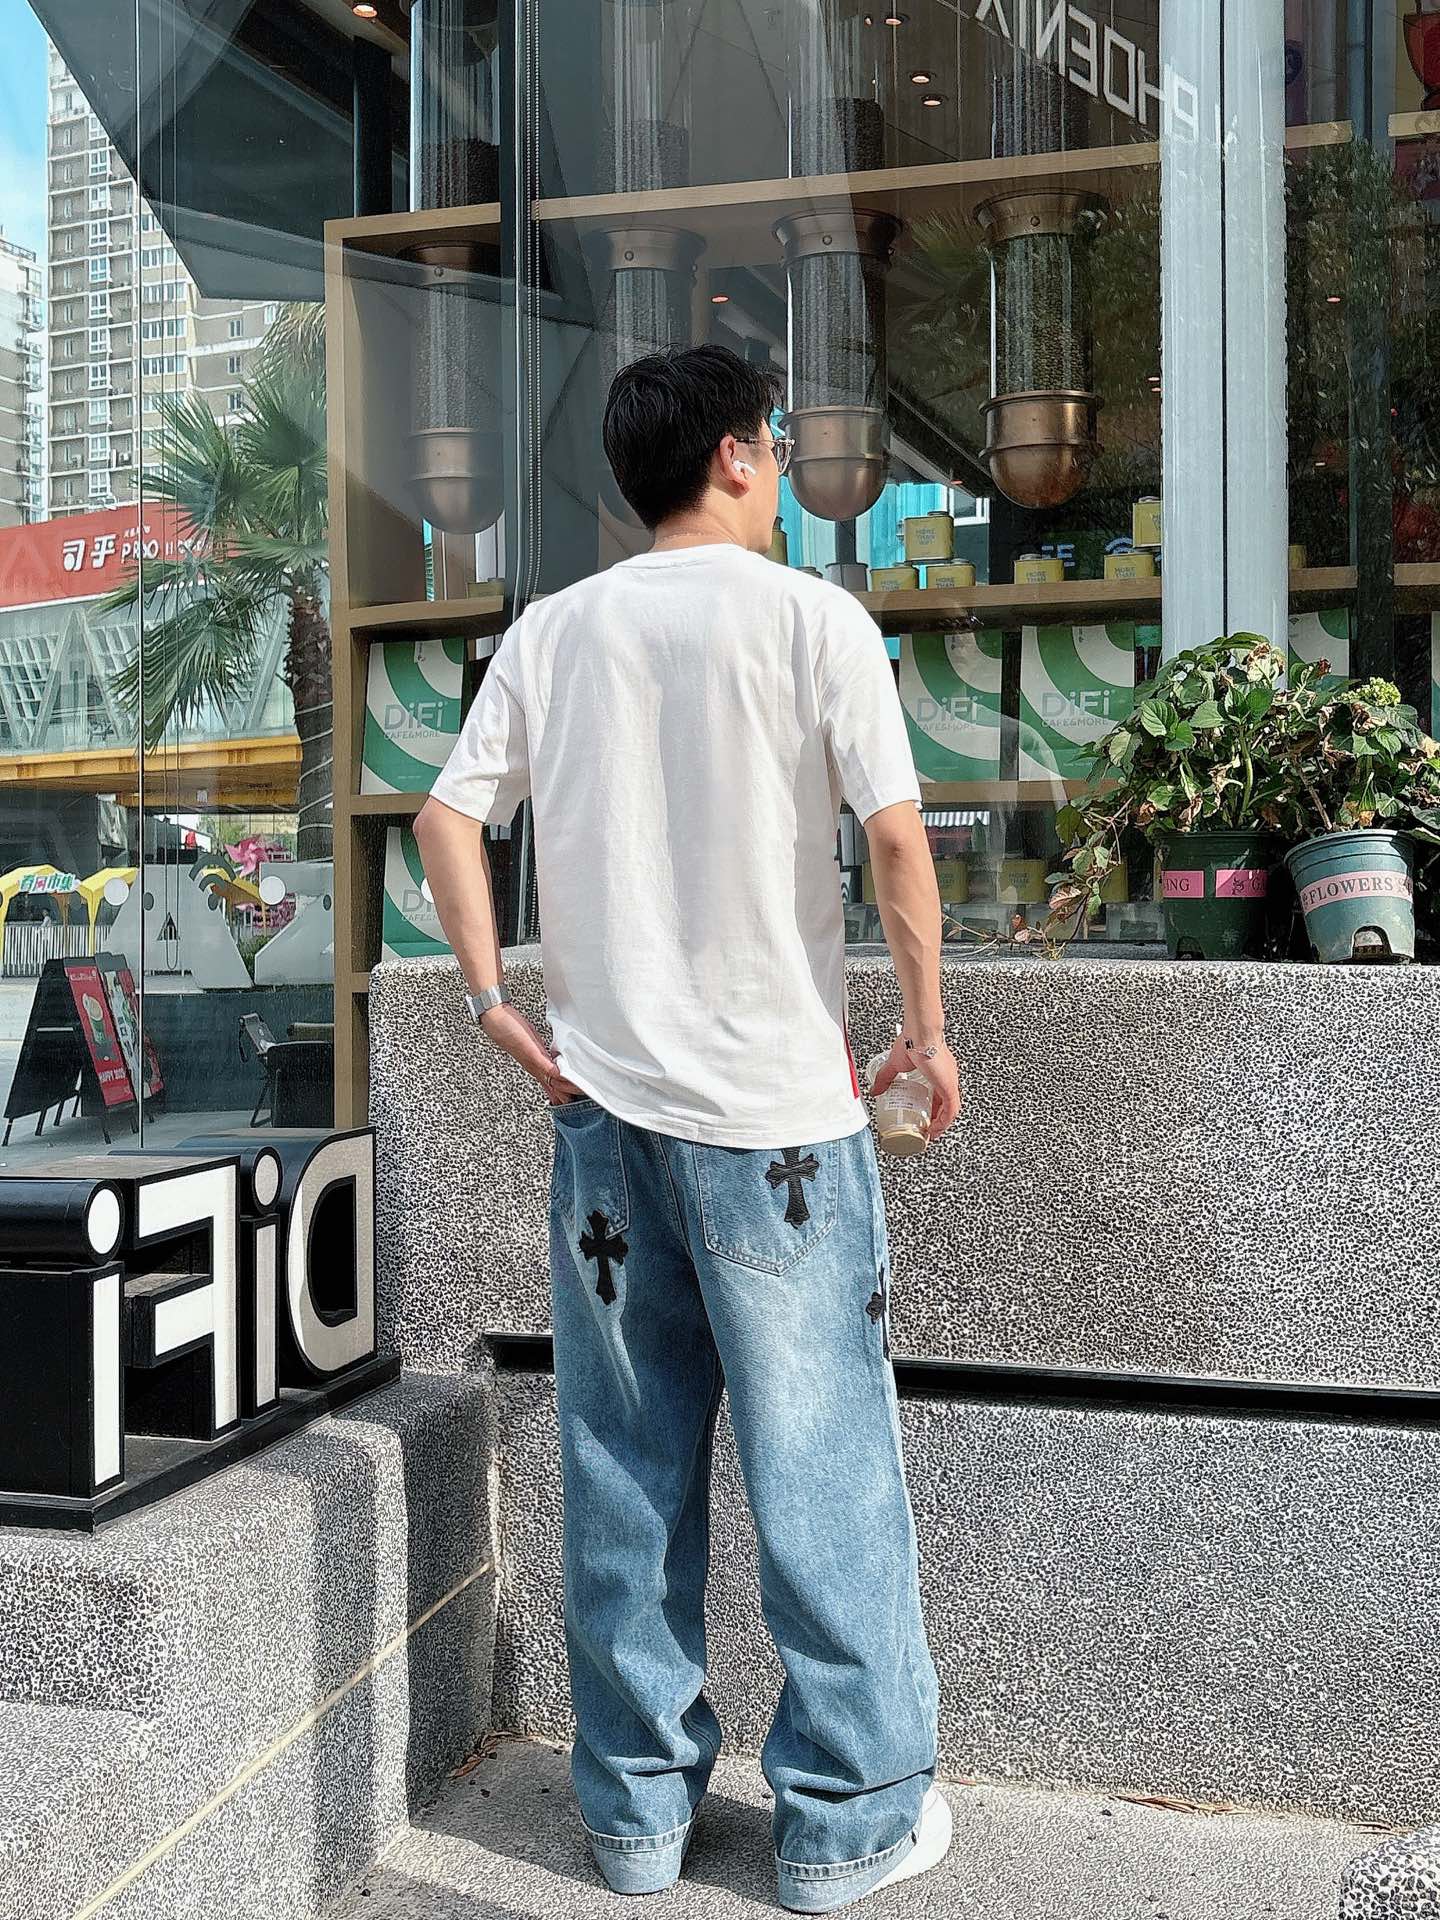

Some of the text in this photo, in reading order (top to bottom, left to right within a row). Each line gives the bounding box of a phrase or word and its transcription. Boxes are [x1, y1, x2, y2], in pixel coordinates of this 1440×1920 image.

[384, 701, 445, 730] DiFi
[917, 695, 978, 725] DiFi
[1041, 689, 1110, 717] DiFi
[402, 889, 432, 913] Di
[1309, 877, 1394, 905] FLOWERS
